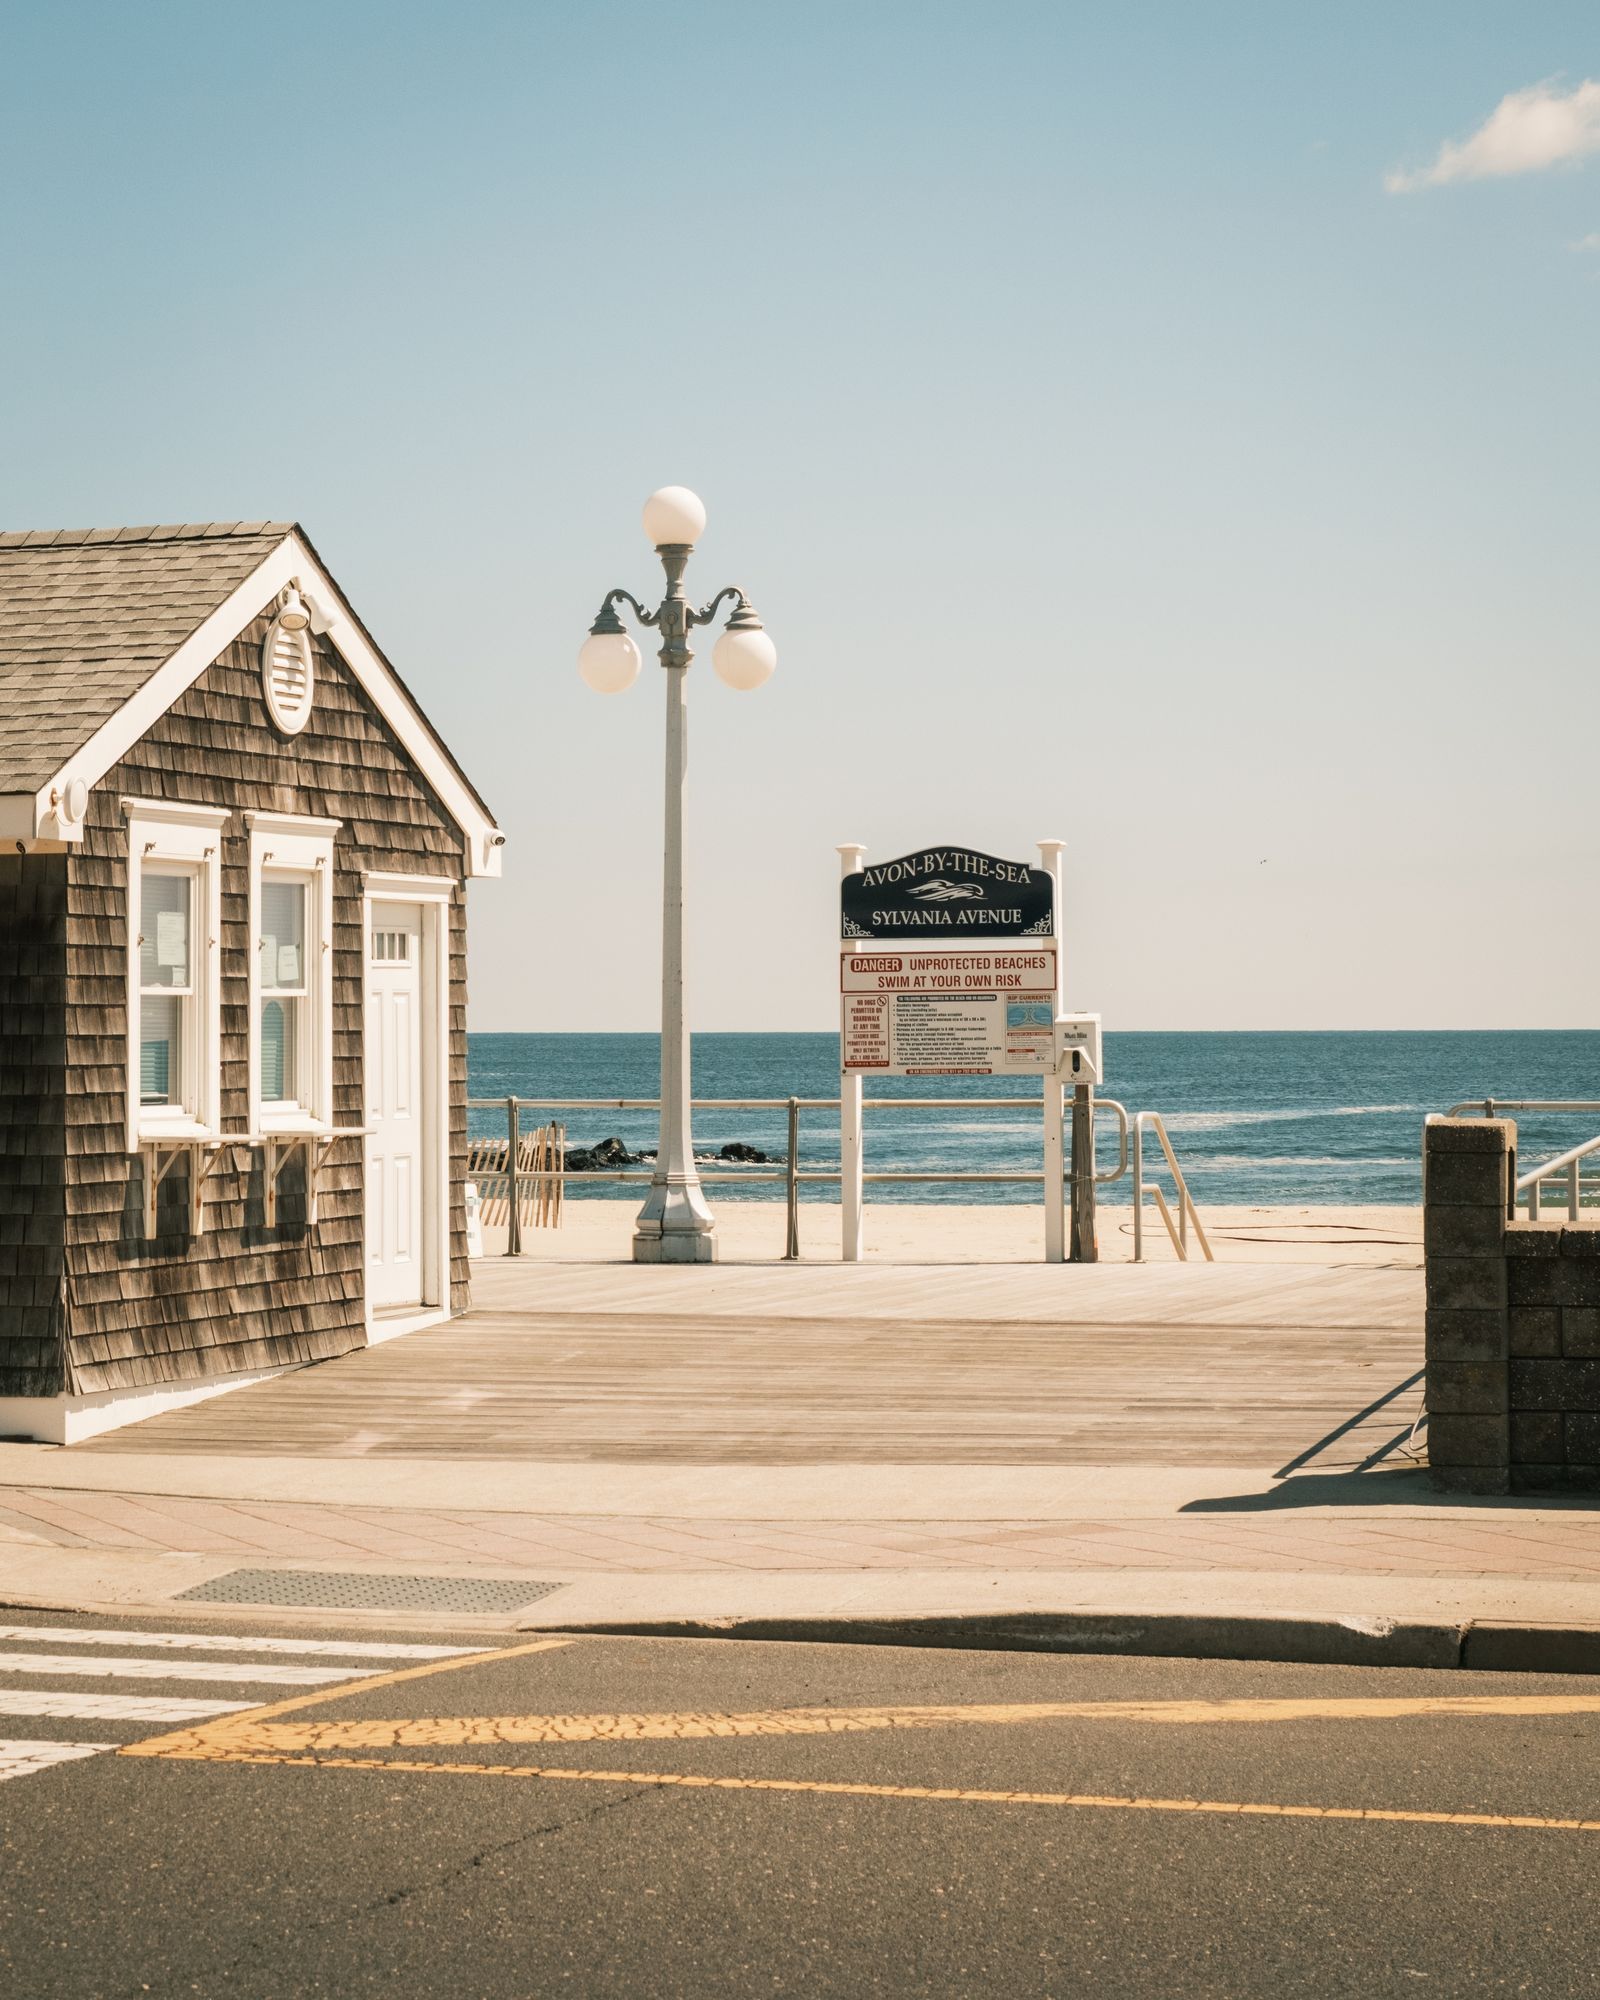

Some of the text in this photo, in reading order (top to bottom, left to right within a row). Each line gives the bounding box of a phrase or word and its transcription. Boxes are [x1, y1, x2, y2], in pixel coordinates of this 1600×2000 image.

[862, 852, 1031, 887] AVON-BY-THE-SEA
[872, 909, 1022, 926] SYLVANIA AVENUE
[853, 957, 1046, 972] DANGER UNPROTECTED BEACHES
[878, 974, 1022, 988] SWIM AT YOUR OWN RISK
